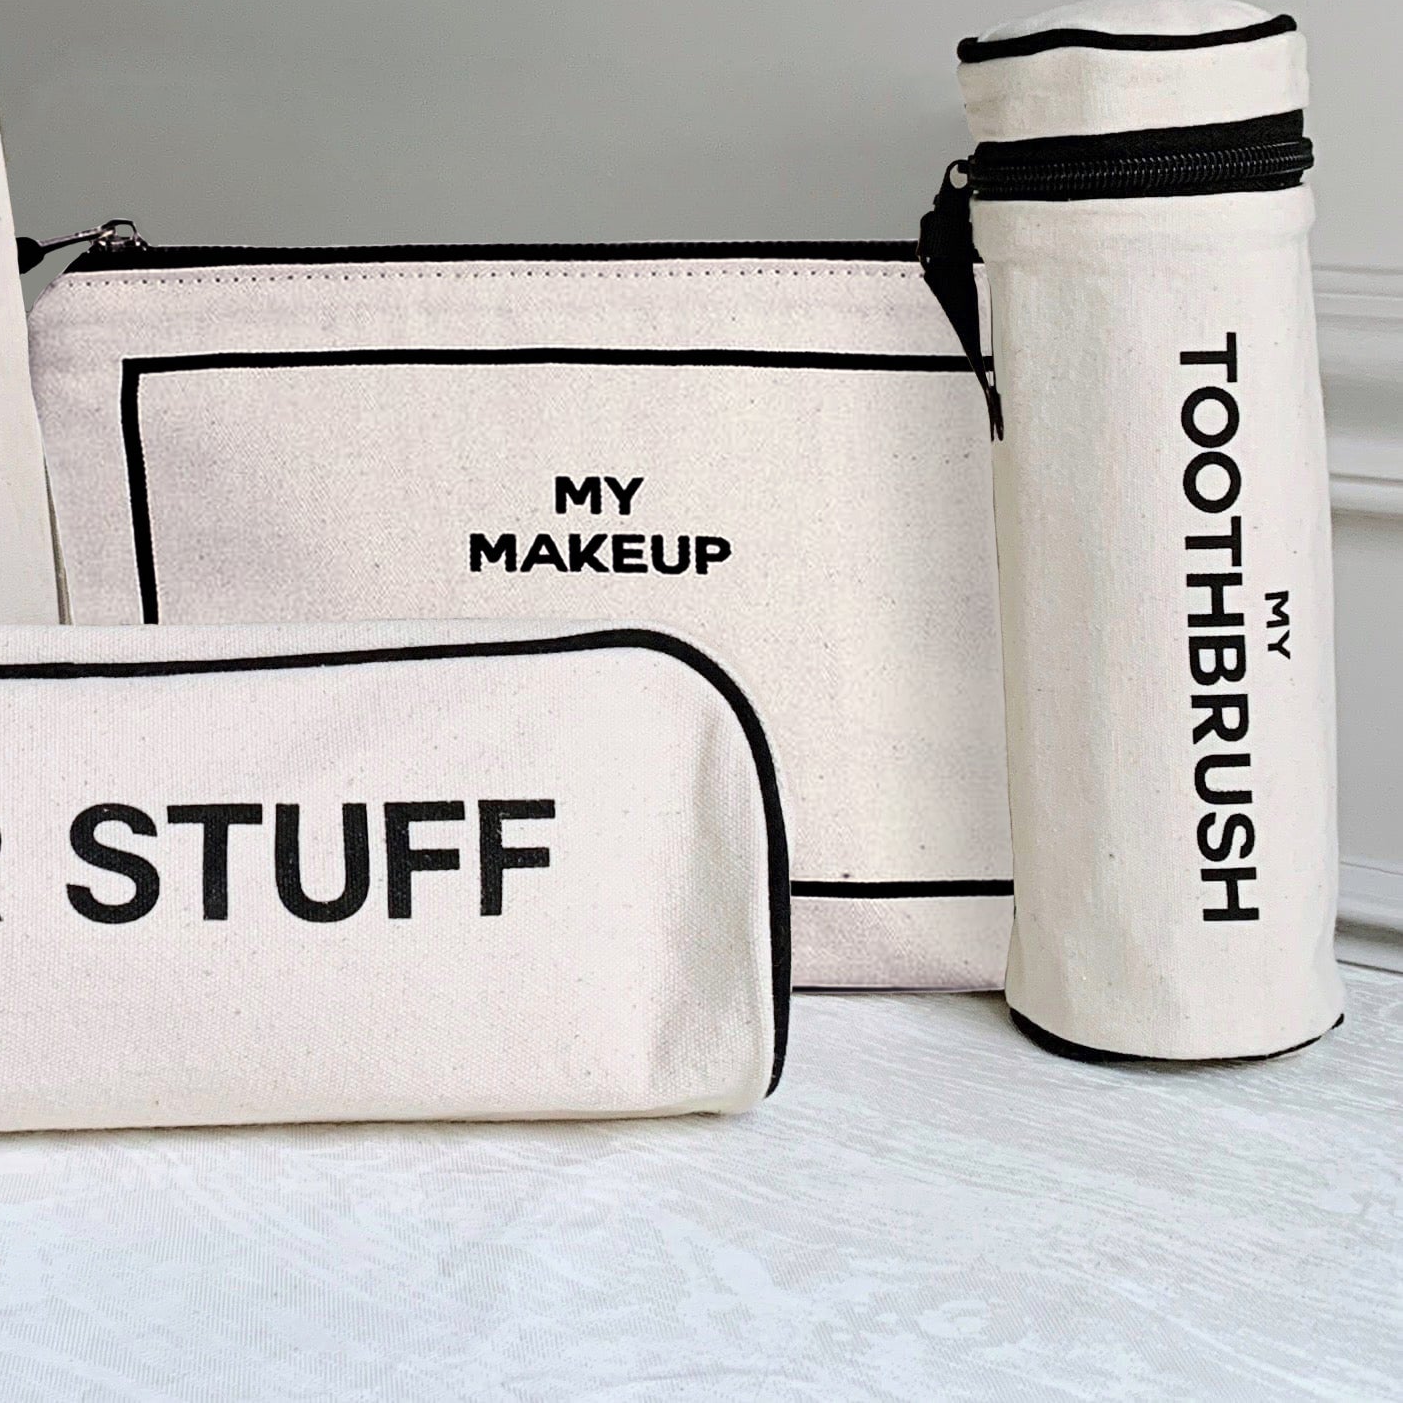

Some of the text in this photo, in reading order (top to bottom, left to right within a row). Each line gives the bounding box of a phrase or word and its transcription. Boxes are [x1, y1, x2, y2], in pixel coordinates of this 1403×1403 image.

[555, 476, 645, 516] MY
[469, 533, 732, 575] MAKEUP
[1179, 331, 1260, 922] TOOTHBRUSH
[1264, 590, 1291, 660] MY
[66, 797, 556, 925] STUFF
